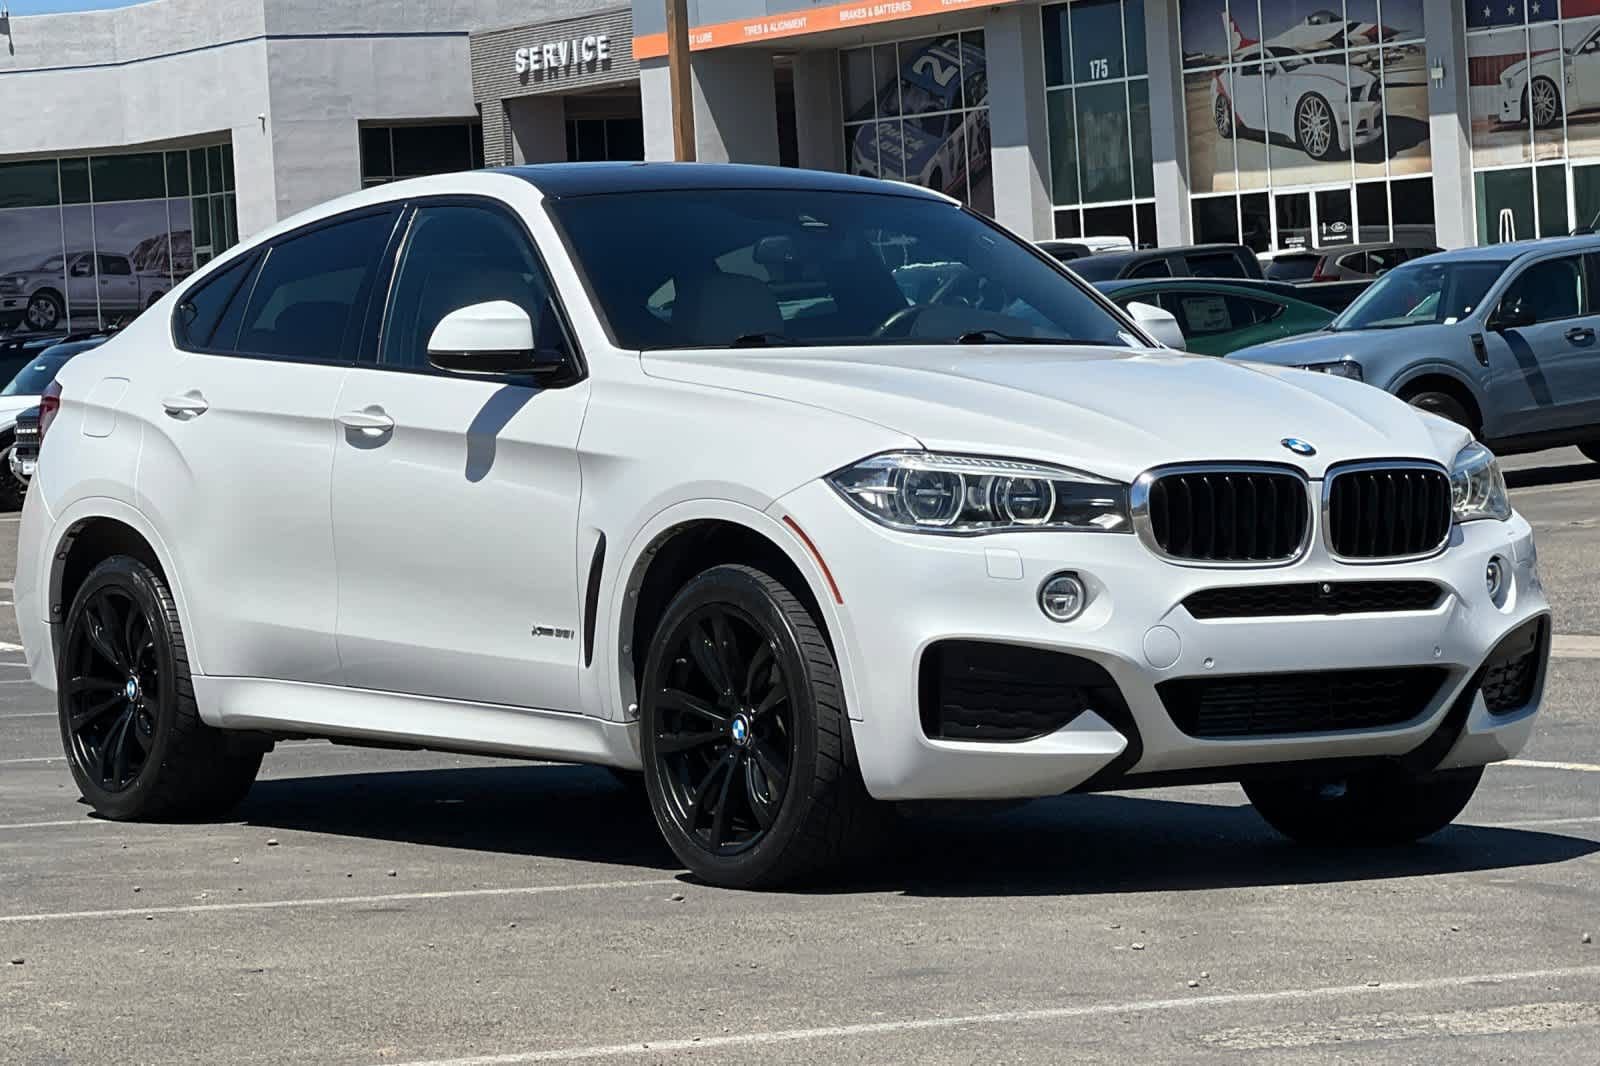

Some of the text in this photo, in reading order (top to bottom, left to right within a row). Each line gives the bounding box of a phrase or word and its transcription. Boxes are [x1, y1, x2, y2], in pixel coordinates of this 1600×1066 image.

[839, 8, 867, 21] BRAKES
[873, 1, 912, 16] BATTERIES
[744, 25, 763, 36] TIRES
[769, 17, 807, 32] ALIGNMENT
[515, 36, 610, 73] SERVICE
[1089, 58, 1109, 79] 175
